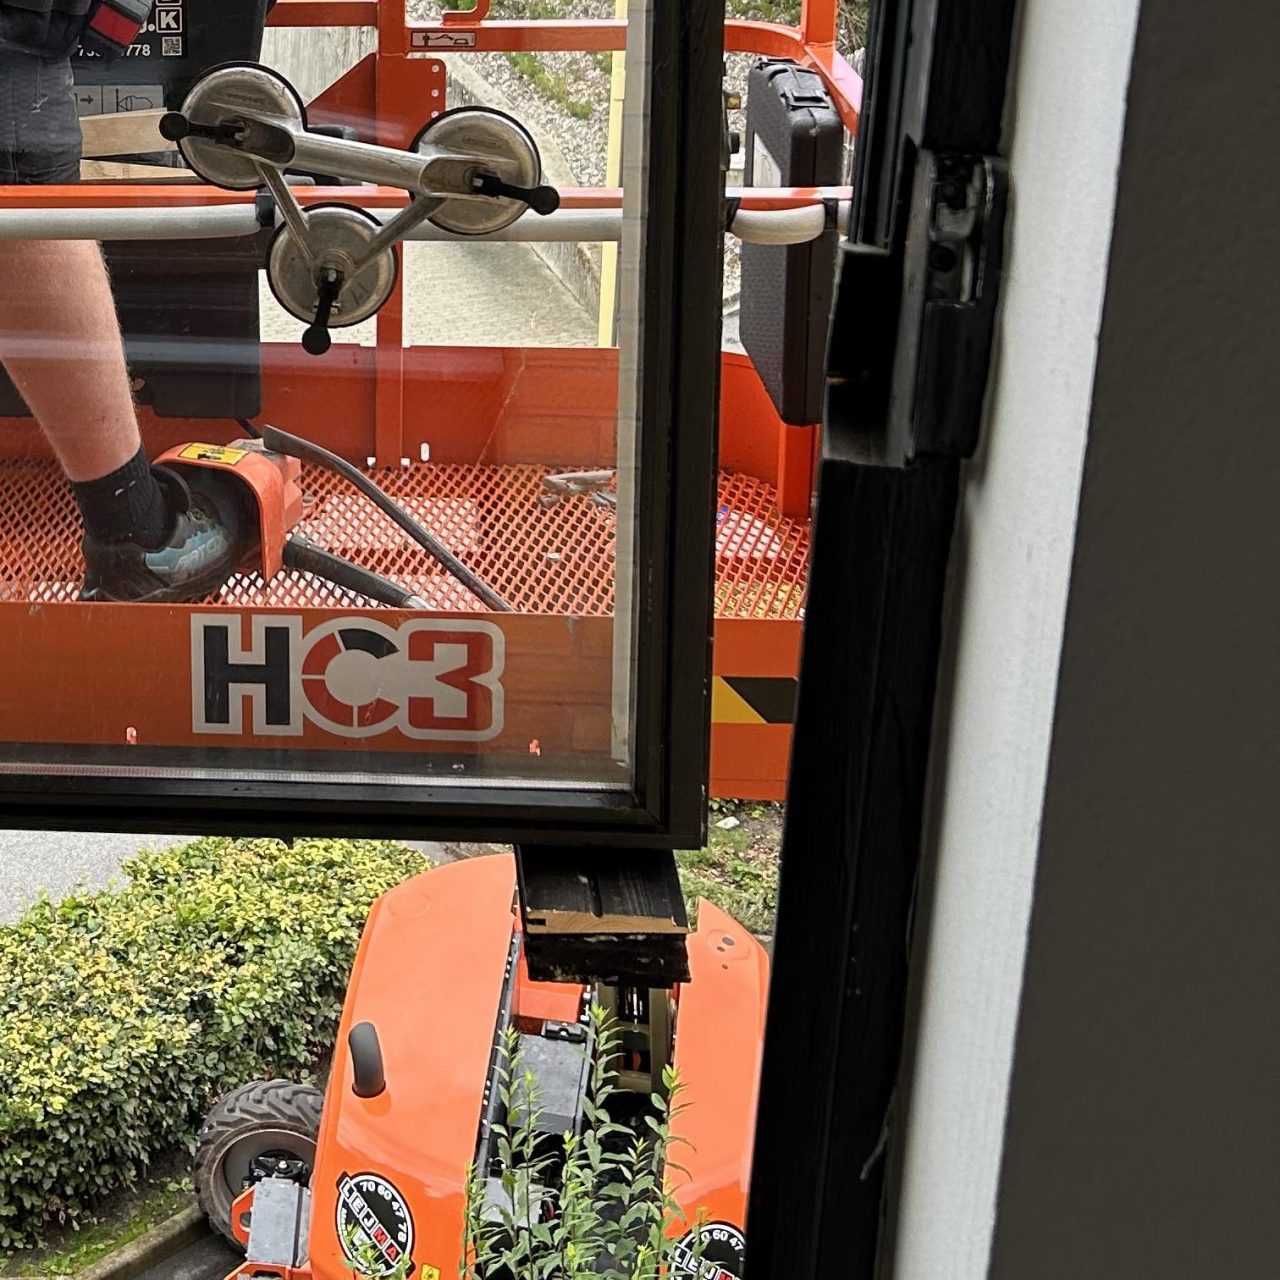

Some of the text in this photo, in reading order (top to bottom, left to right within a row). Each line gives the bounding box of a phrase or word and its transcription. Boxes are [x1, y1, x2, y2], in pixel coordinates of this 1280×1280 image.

[191, 613, 505, 741] HC3
[341, 1180, 400, 1263] LEJMA
[360, 1181, 376, 1192] 70
[397, 1222, 408, 1243] 78
[712, 1230, 728, 1241] 60
